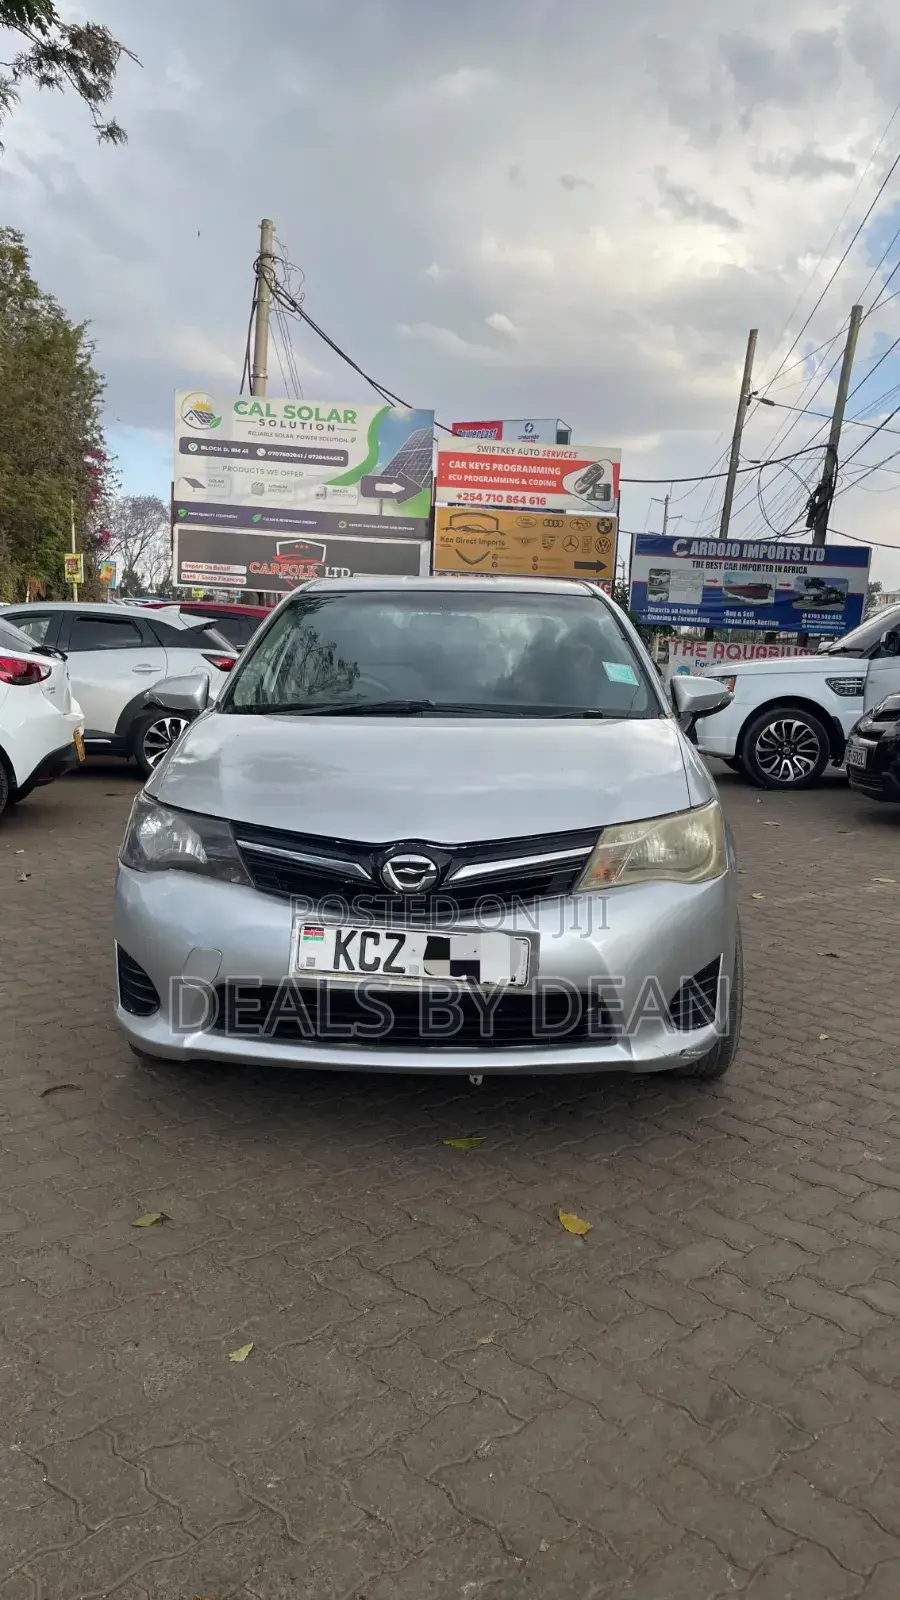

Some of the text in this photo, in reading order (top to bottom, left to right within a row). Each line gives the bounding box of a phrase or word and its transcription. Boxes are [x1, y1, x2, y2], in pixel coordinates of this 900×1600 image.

[233, 400, 357, 425] CAL SOLAR
[258, 418, 336, 433] SOLUTION
[247, 430, 273, 438] RELIABLE
[476, 444, 578, 459] SWIFTKEY AUTO SERVICES
[222, 465, 304, 478] PRODUCTS WE OFFER
[448, 460, 561, 475] CAR KEYS PROGRAMMING
[463, 474, 520, 485] PROGRAMMING
[528, 478, 557, 488] CODING
[456, 492, 547, 506] +254 710 864 616
[440, 535, 506, 548] Ken Direct Imports
[672, 538, 825, 562] CARDOJO IMPORTS LTD
[184, 563, 204, 571] Import
[249, 561, 318, 578] CARFOLK
[324, 566, 351, 578] LTD
[692, 560, 808, 575] THE BEST CAR IMPORTER IN AFRICA
[671, 639, 707, 658] THE
[695, 659, 709, 668] For
[332, 928, 407, 974] KCZ
